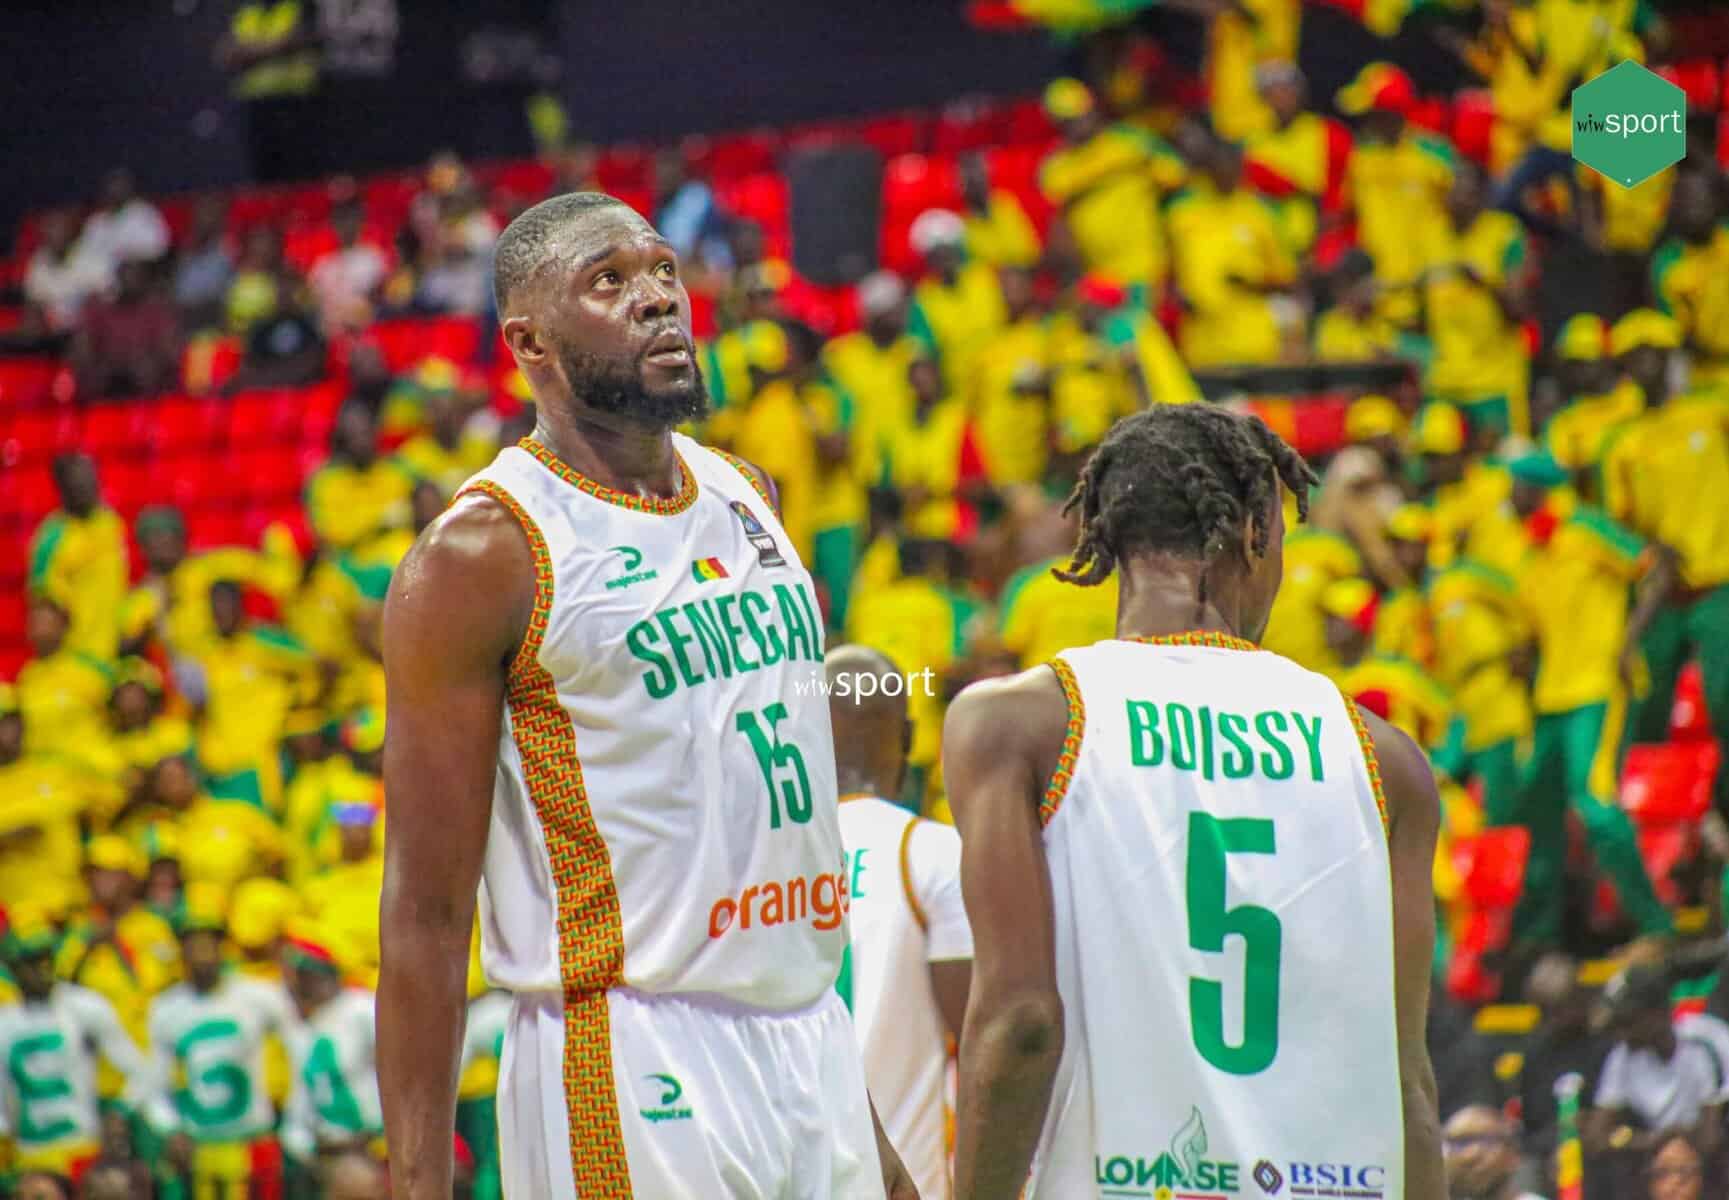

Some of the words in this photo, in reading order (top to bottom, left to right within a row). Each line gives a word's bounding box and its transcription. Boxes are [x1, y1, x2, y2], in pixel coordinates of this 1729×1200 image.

[626, 583, 825, 700] SENEGAL
[736, 702, 813, 829] 15
[1126, 698, 1325, 782] BOISSY
[1185, 811, 1282, 1076] 5
[9, 1033, 76, 1143] E
[1289, 1162, 1385, 1189] BSIC
